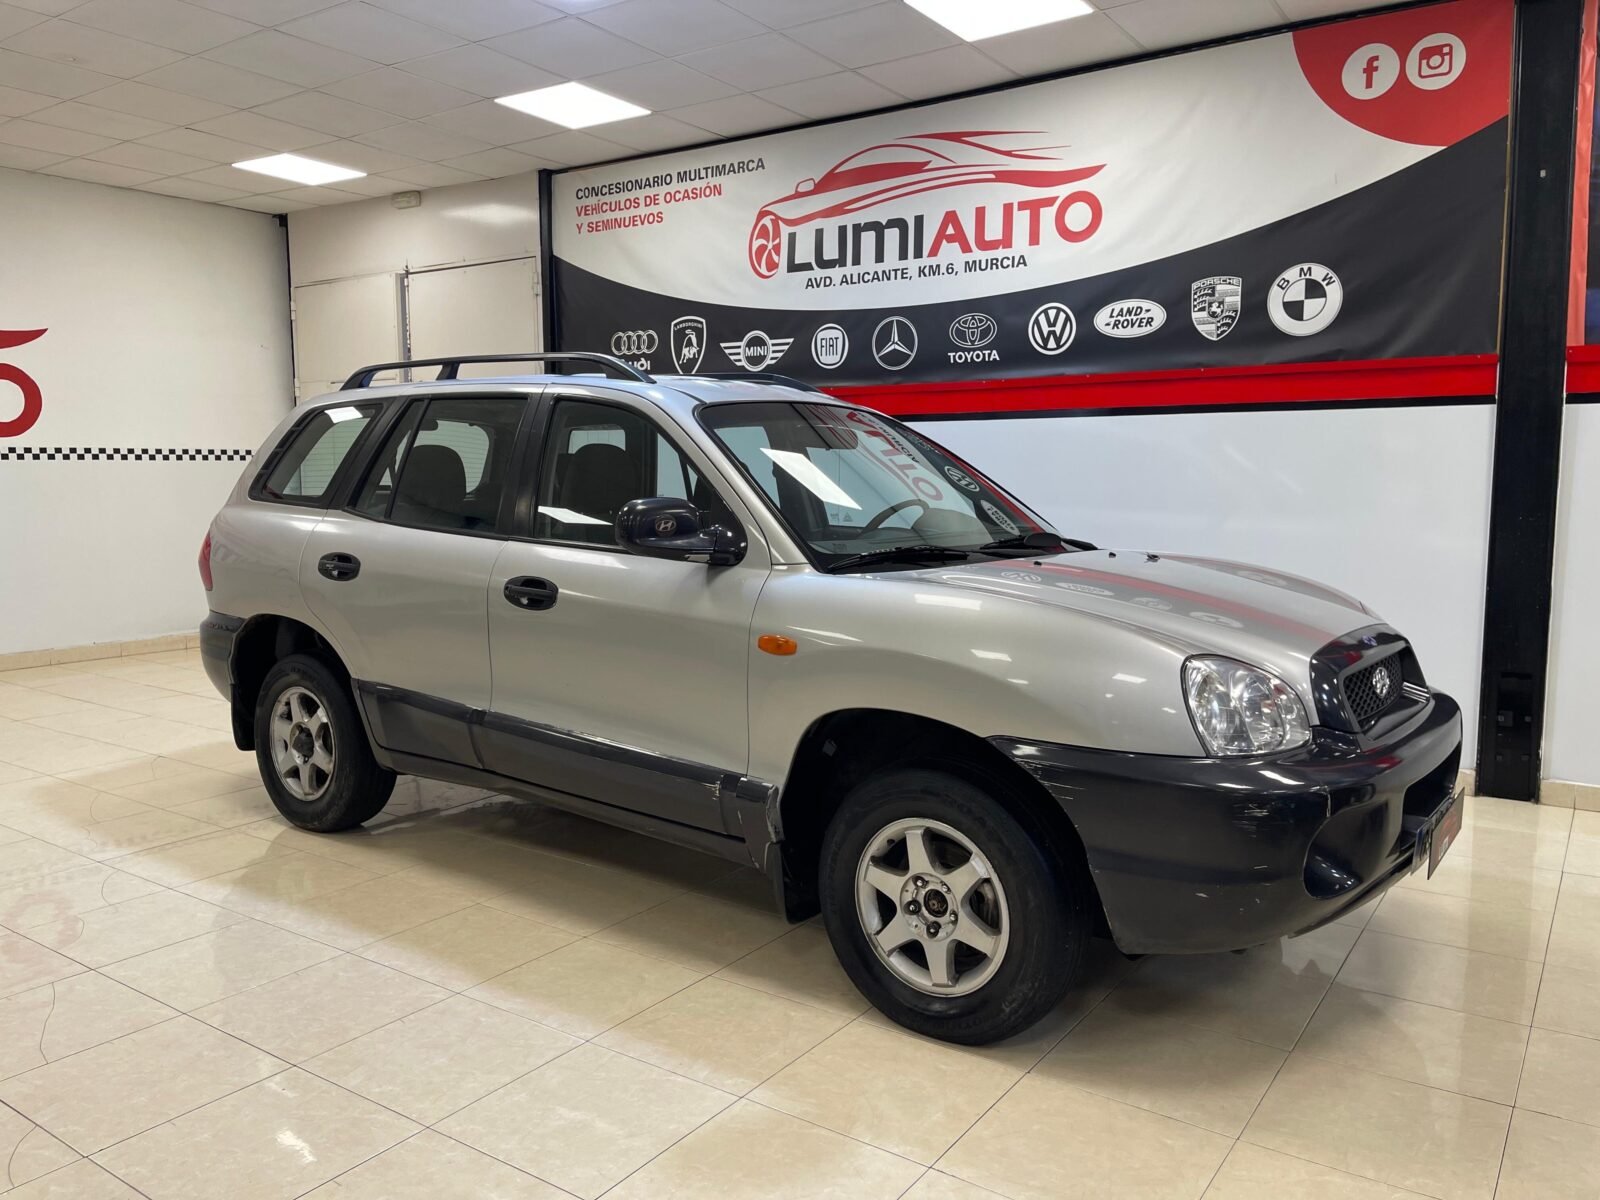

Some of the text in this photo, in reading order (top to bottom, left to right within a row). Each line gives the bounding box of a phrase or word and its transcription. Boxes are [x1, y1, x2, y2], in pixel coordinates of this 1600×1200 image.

[575, 157, 766, 200] CONCESIONARIO MULTIMARCA
[575, 182, 722, 217] VEHÍCULOS DE OCASIÓN
[575, 211, 664, 235] Y SEMINUEVOS
[804, 254, 1028, 290] AVD. ALICANTE, KM.6, MURCIA
[1192, 277, 1241, 290] PORSCHE
[1109, 306, 1141, 319] LAND
[1111, 315, 1154, 331] ROVER
[745, 345, 768, 357] MINI
[820, 335, 840, 358] FIAT
[947, 349, 1001, 364] TOYOTA
